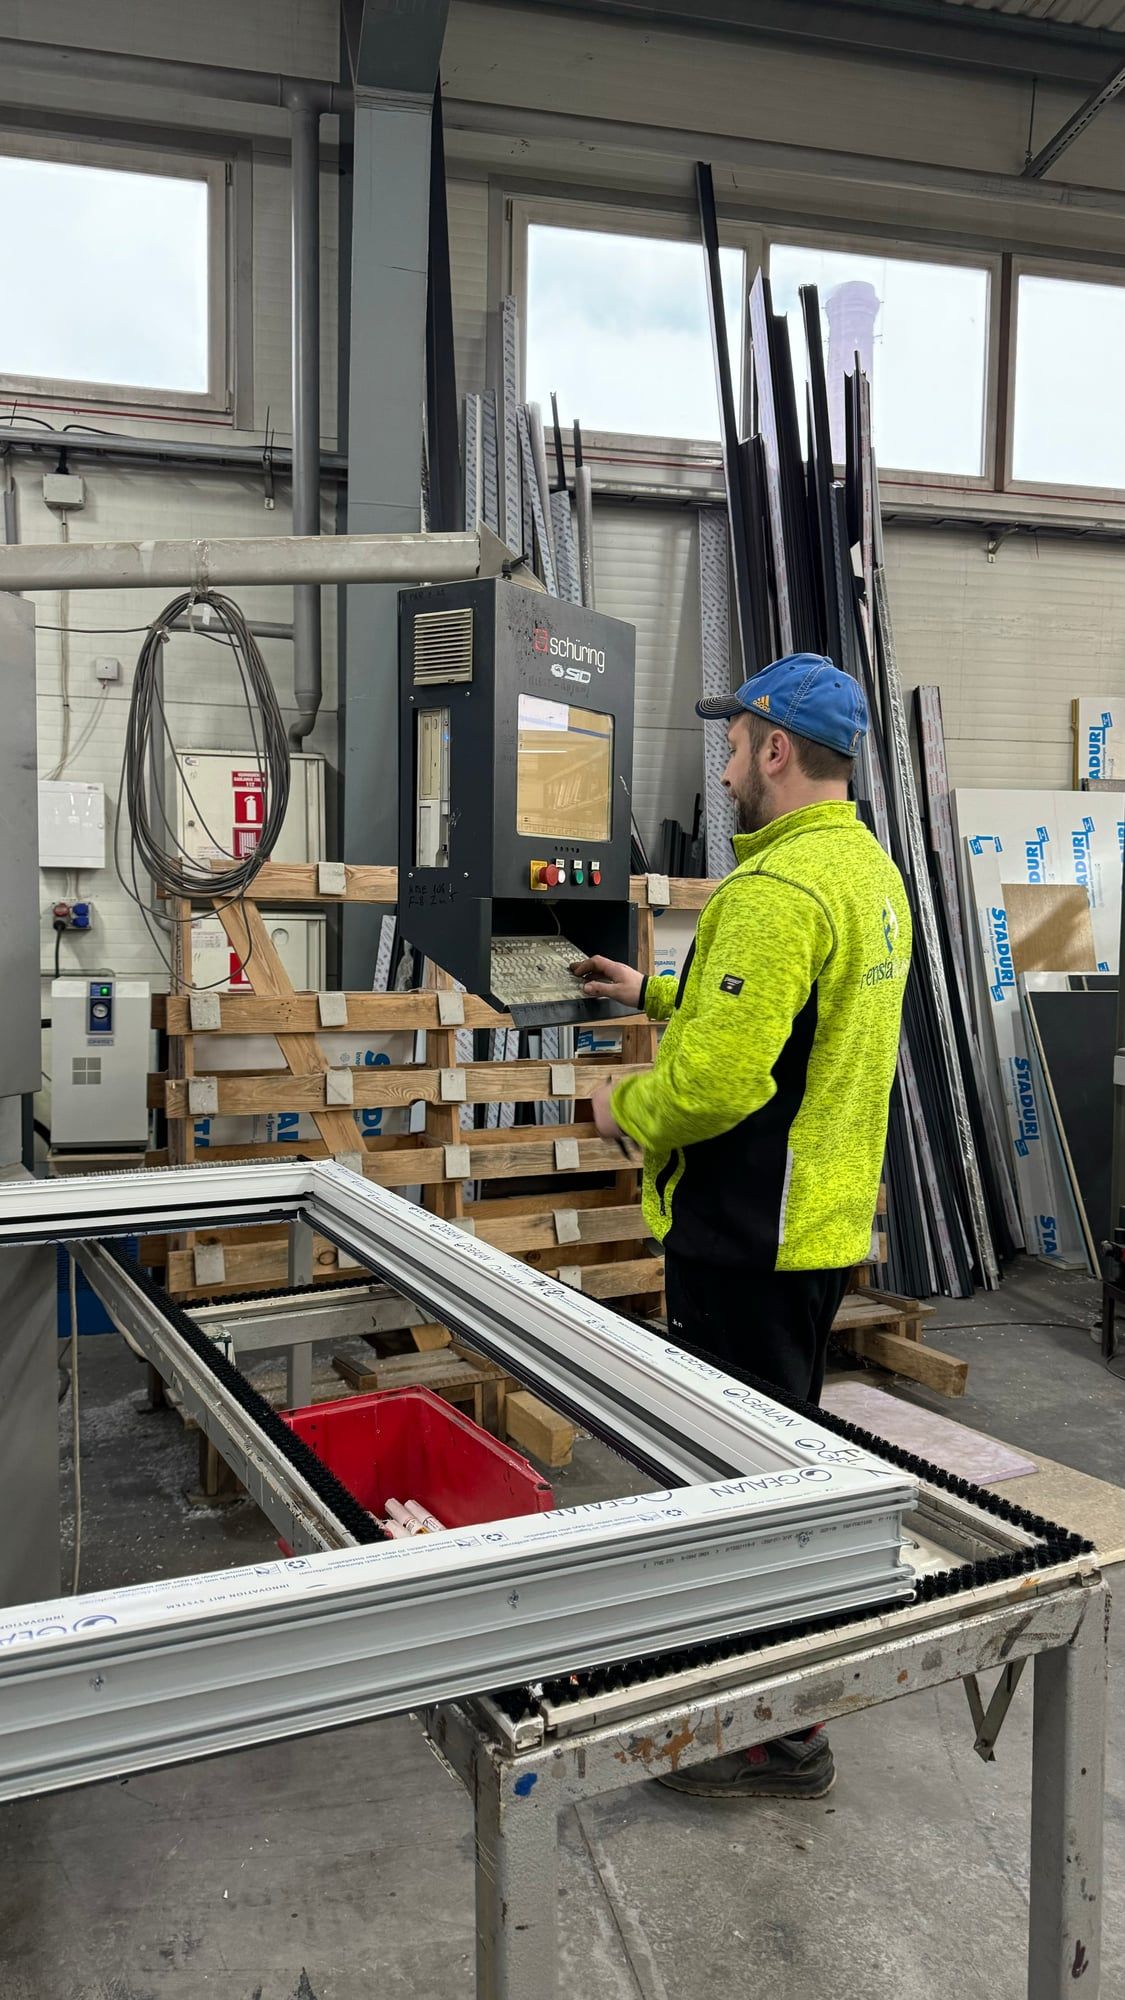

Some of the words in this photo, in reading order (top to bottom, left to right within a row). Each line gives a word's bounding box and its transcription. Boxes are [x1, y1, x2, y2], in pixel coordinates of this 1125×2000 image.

[549, 637, 605, 674] schüring
[1088, 731, 1101, 779] ADUR
[1073, 836, 1088, 885] ADUR
[741, 1397, 802, 1428] GEALAN
[709, 1475, 800, 1497] GEALAN
